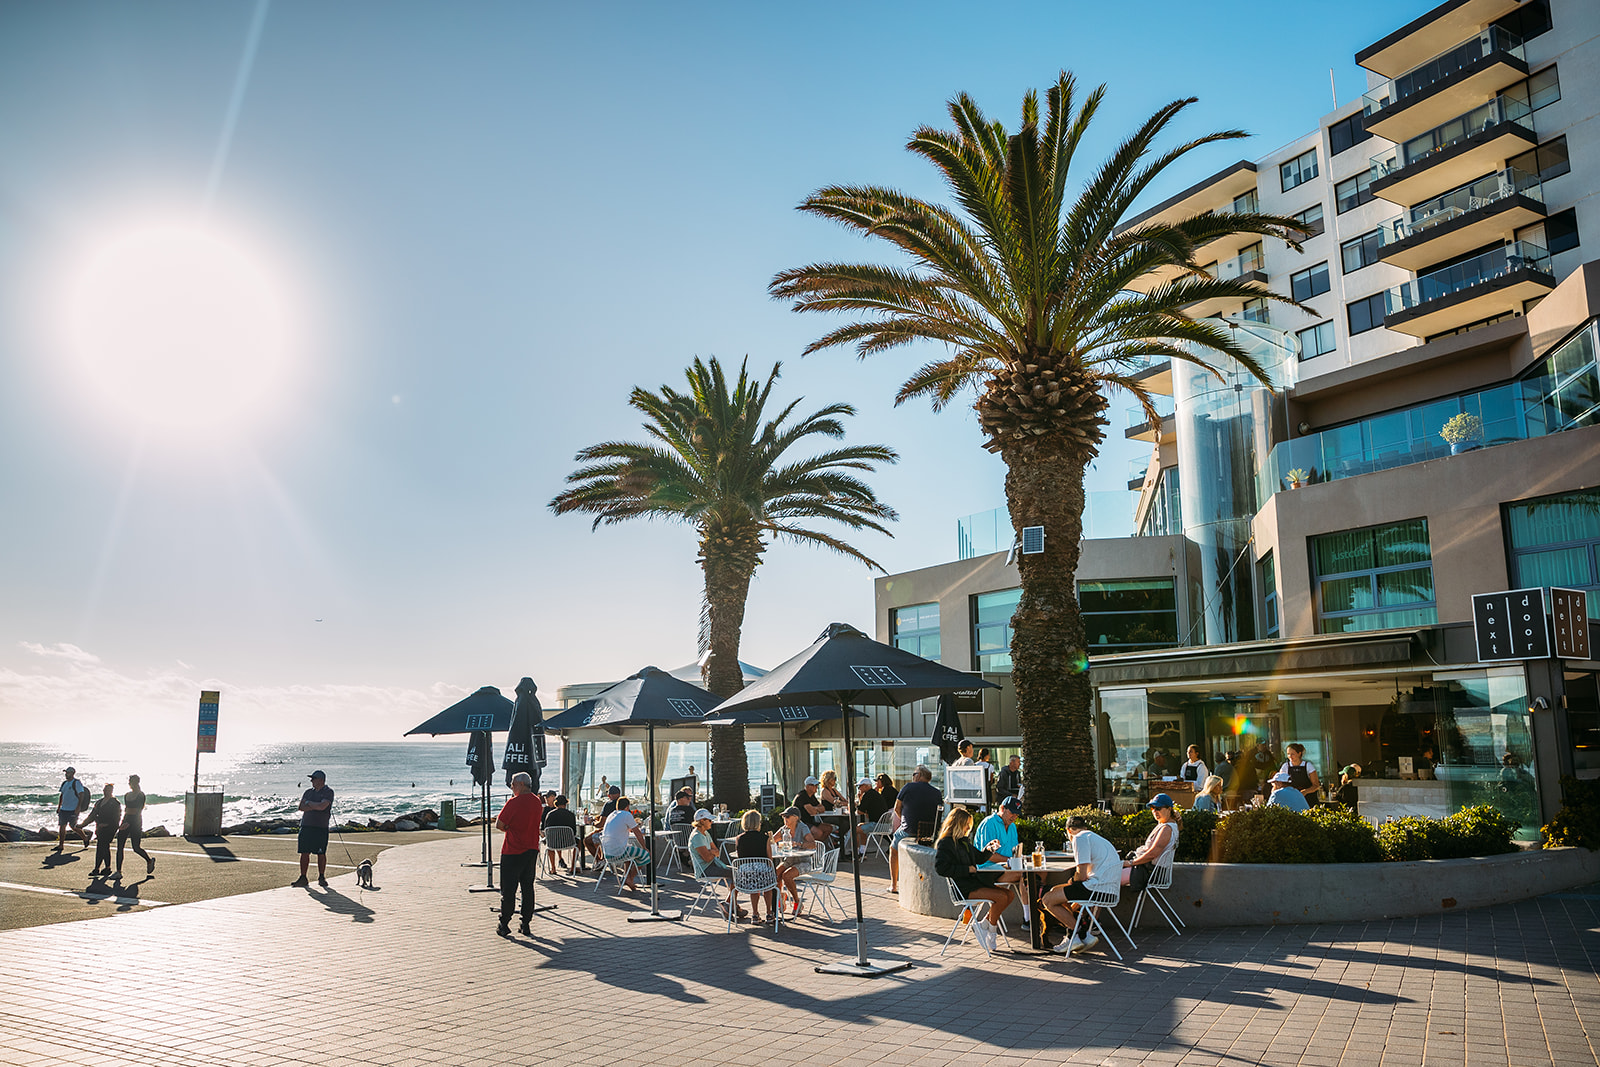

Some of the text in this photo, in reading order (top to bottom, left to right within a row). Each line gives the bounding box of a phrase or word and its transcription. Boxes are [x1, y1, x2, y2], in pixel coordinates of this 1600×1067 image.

[1486, 602, 1497, 654] next
[1521, 595, 1533, 651] door
[1558, 597, 1567, 650] next
[1575, 596, 1583, 651] door
